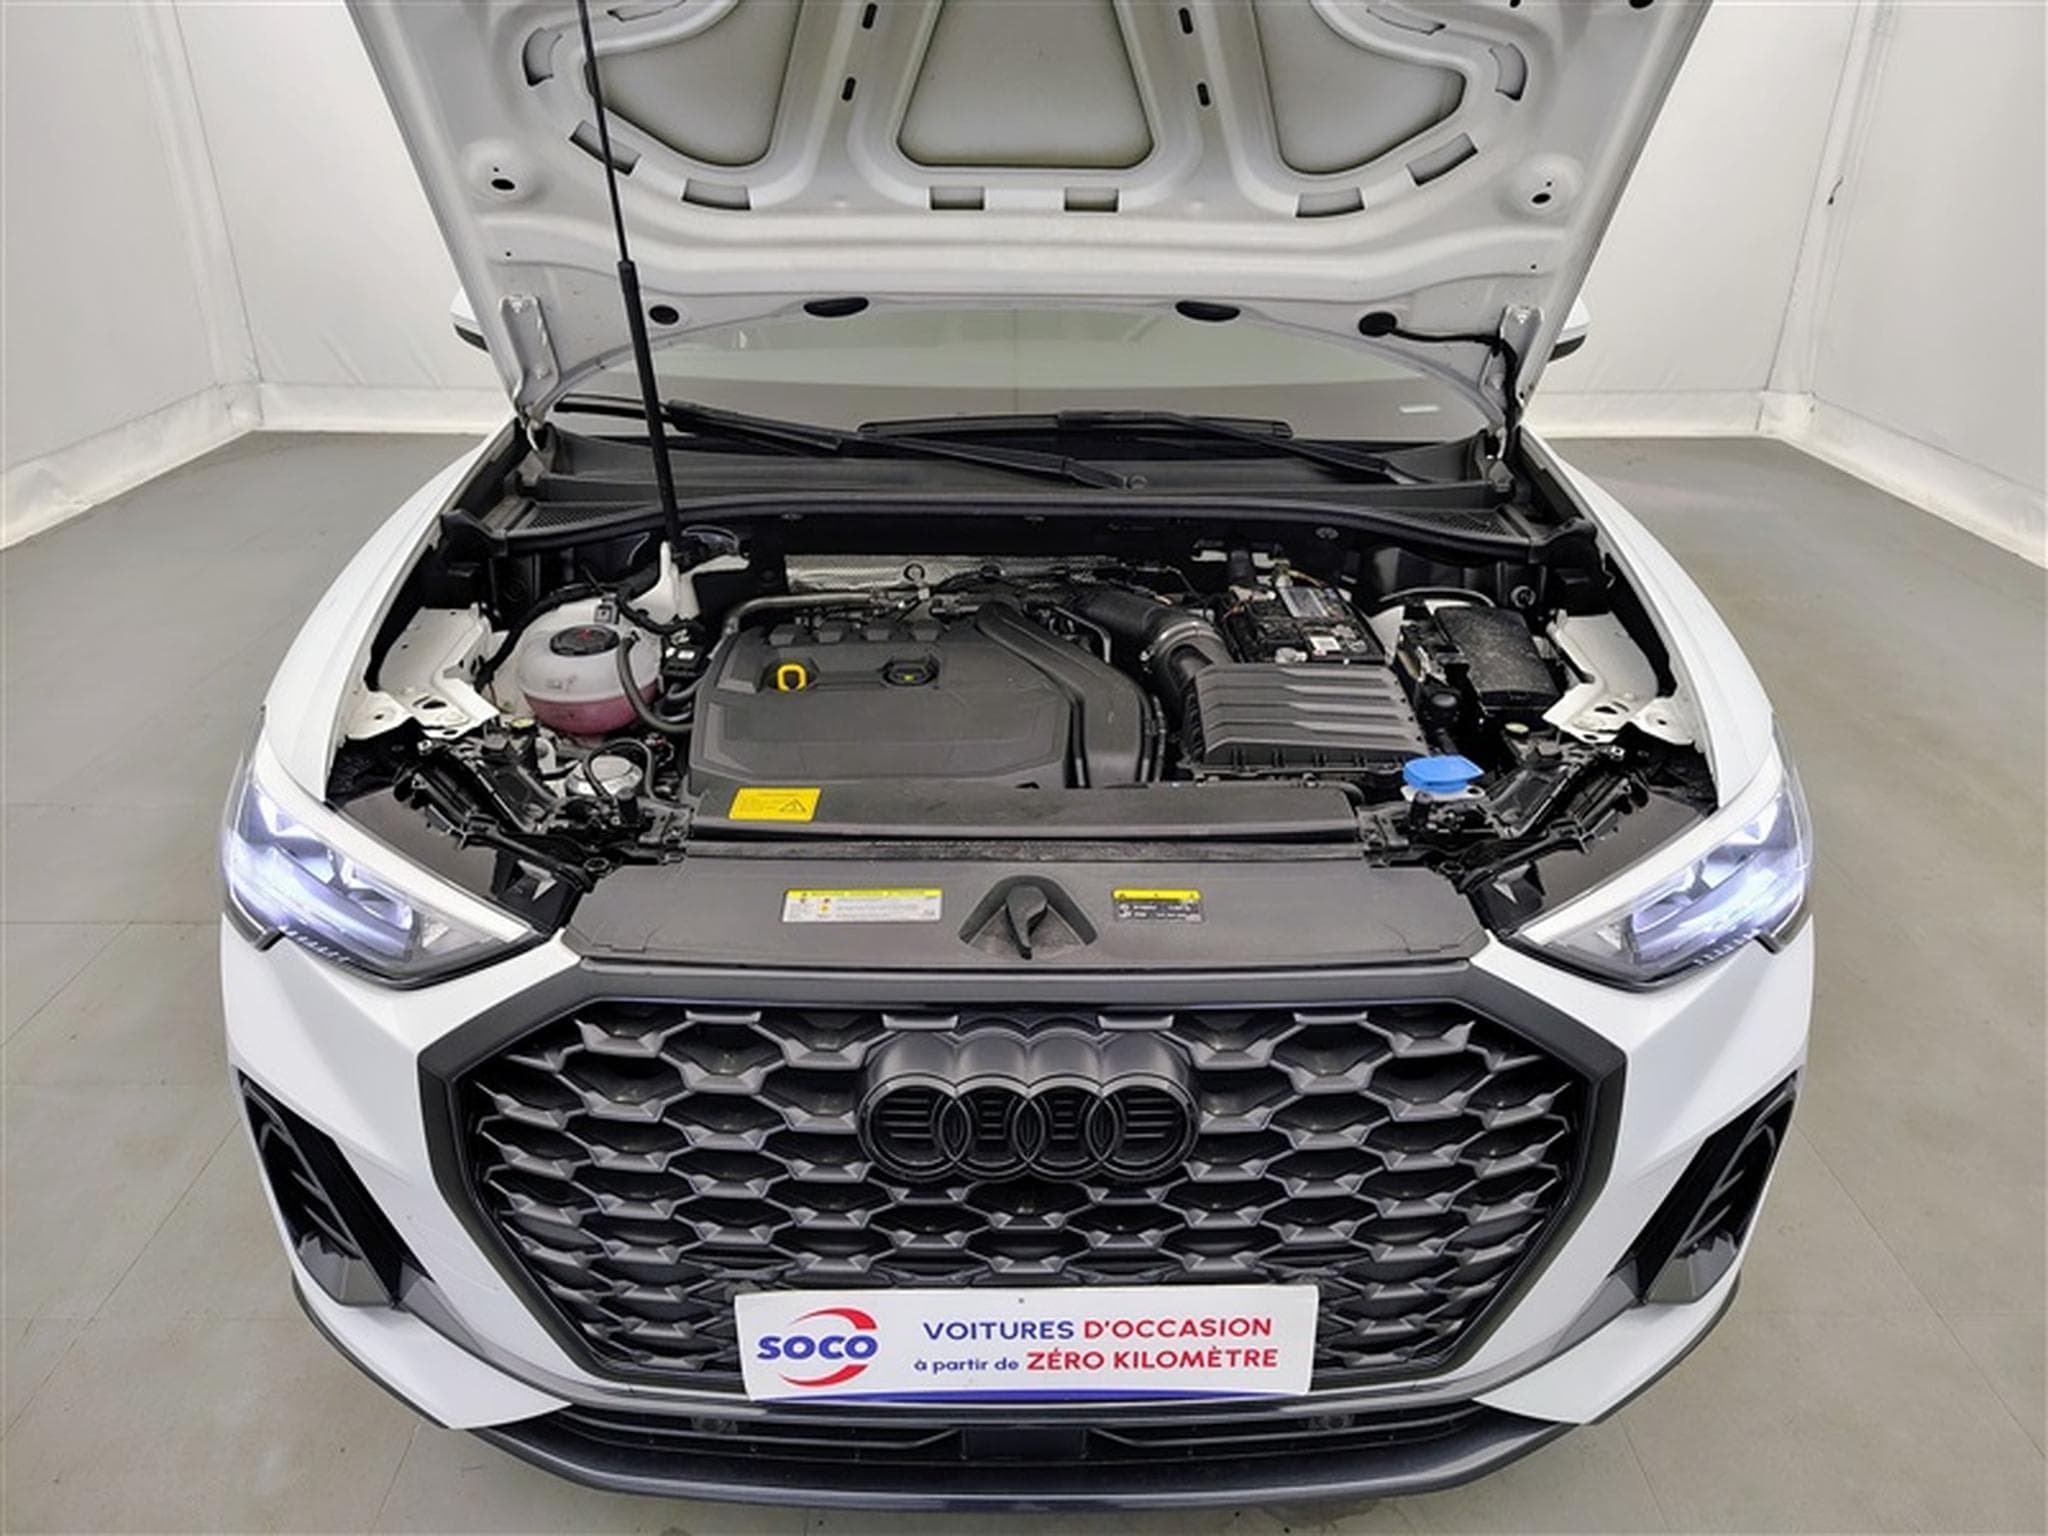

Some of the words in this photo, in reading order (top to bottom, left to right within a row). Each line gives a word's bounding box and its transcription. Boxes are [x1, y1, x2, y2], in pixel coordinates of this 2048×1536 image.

[923, 1320, 1075, 1341] VOITURES
[1083, 1317, 1272, 1340] D'OCCASION
[757, 1334, 878, 1361] SOCO
[914, 1357, 928, 1371] à
[933, 1356, 988, 1374] partir
[994, 1357, 1019, 1371] de
[1026, 1348, 1105, 1371] ZÉRO
[1113, 1346, 1278, 1370] KILOMÈTRE
